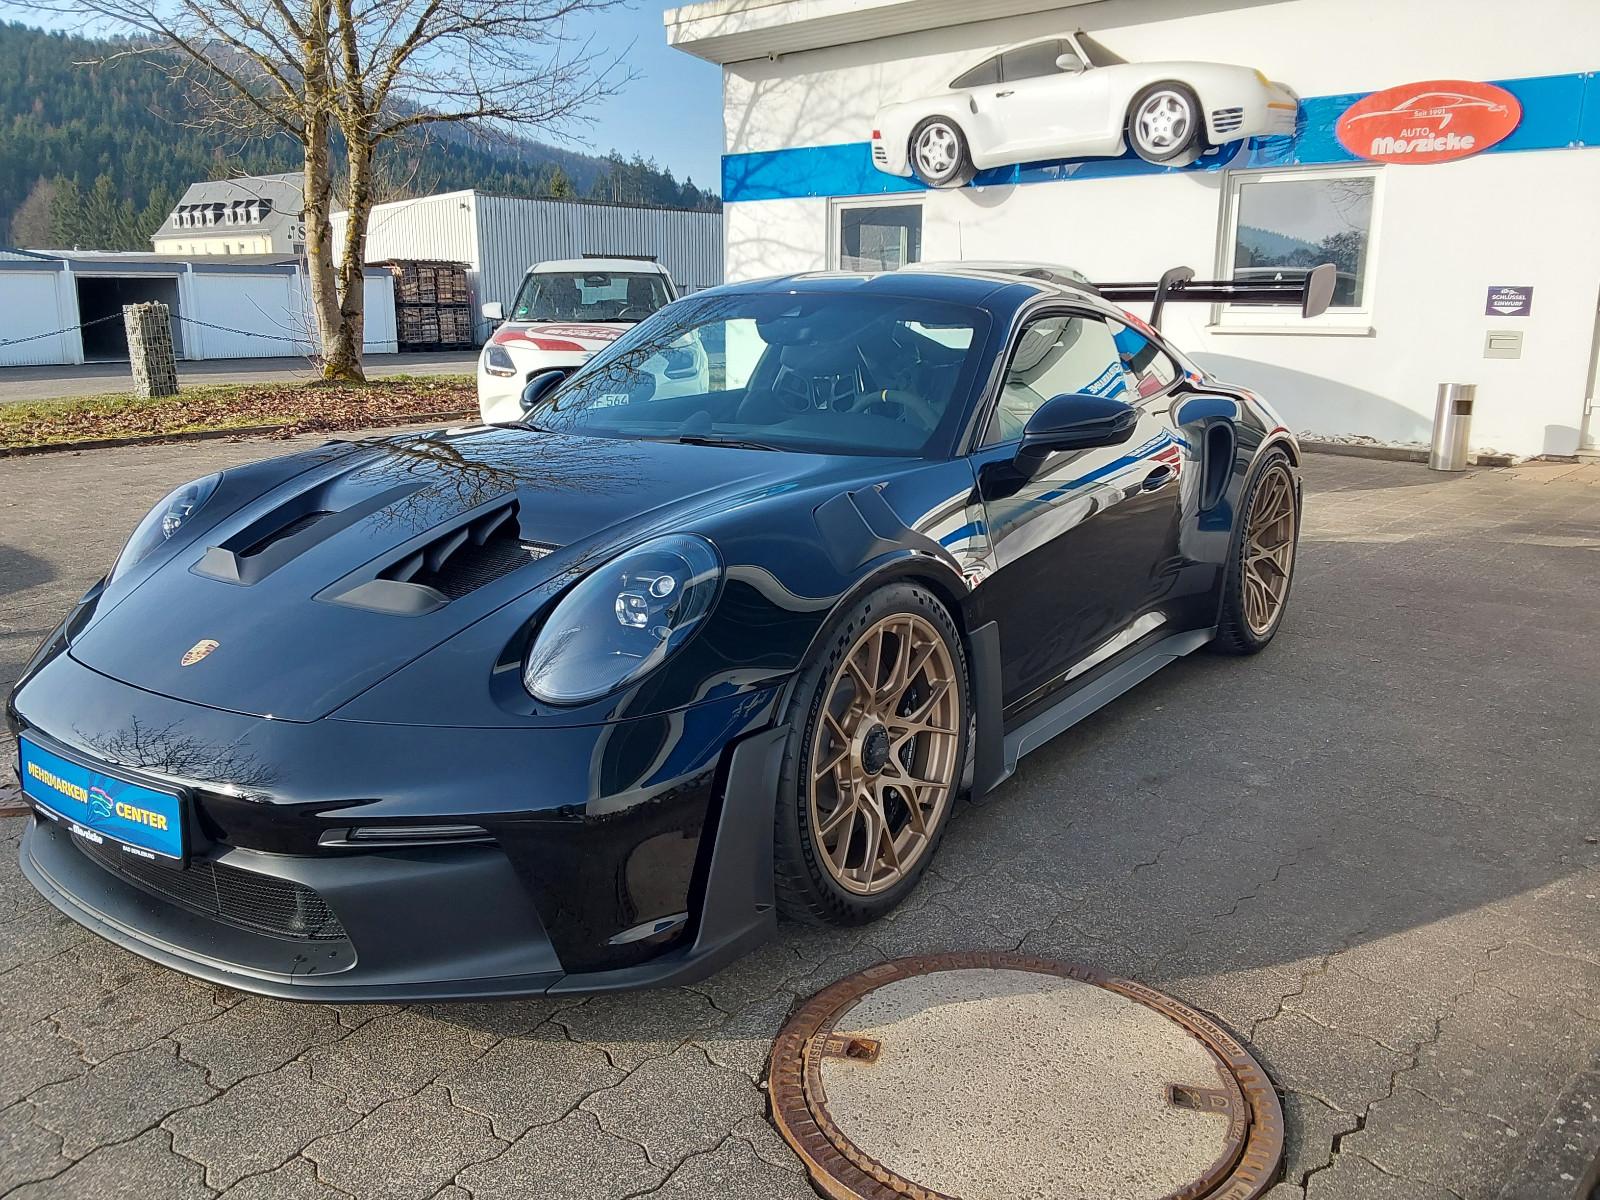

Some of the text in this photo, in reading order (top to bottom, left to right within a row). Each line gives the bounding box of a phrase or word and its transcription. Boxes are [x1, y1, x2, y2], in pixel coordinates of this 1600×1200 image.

[1400, 128, 1429, 138] AUTO
[803, 719, 814, 754] SPORT
[811, 696, 820, 716] CUP
[27, 761, 168, 831] MEHRMARKEN CENTER
